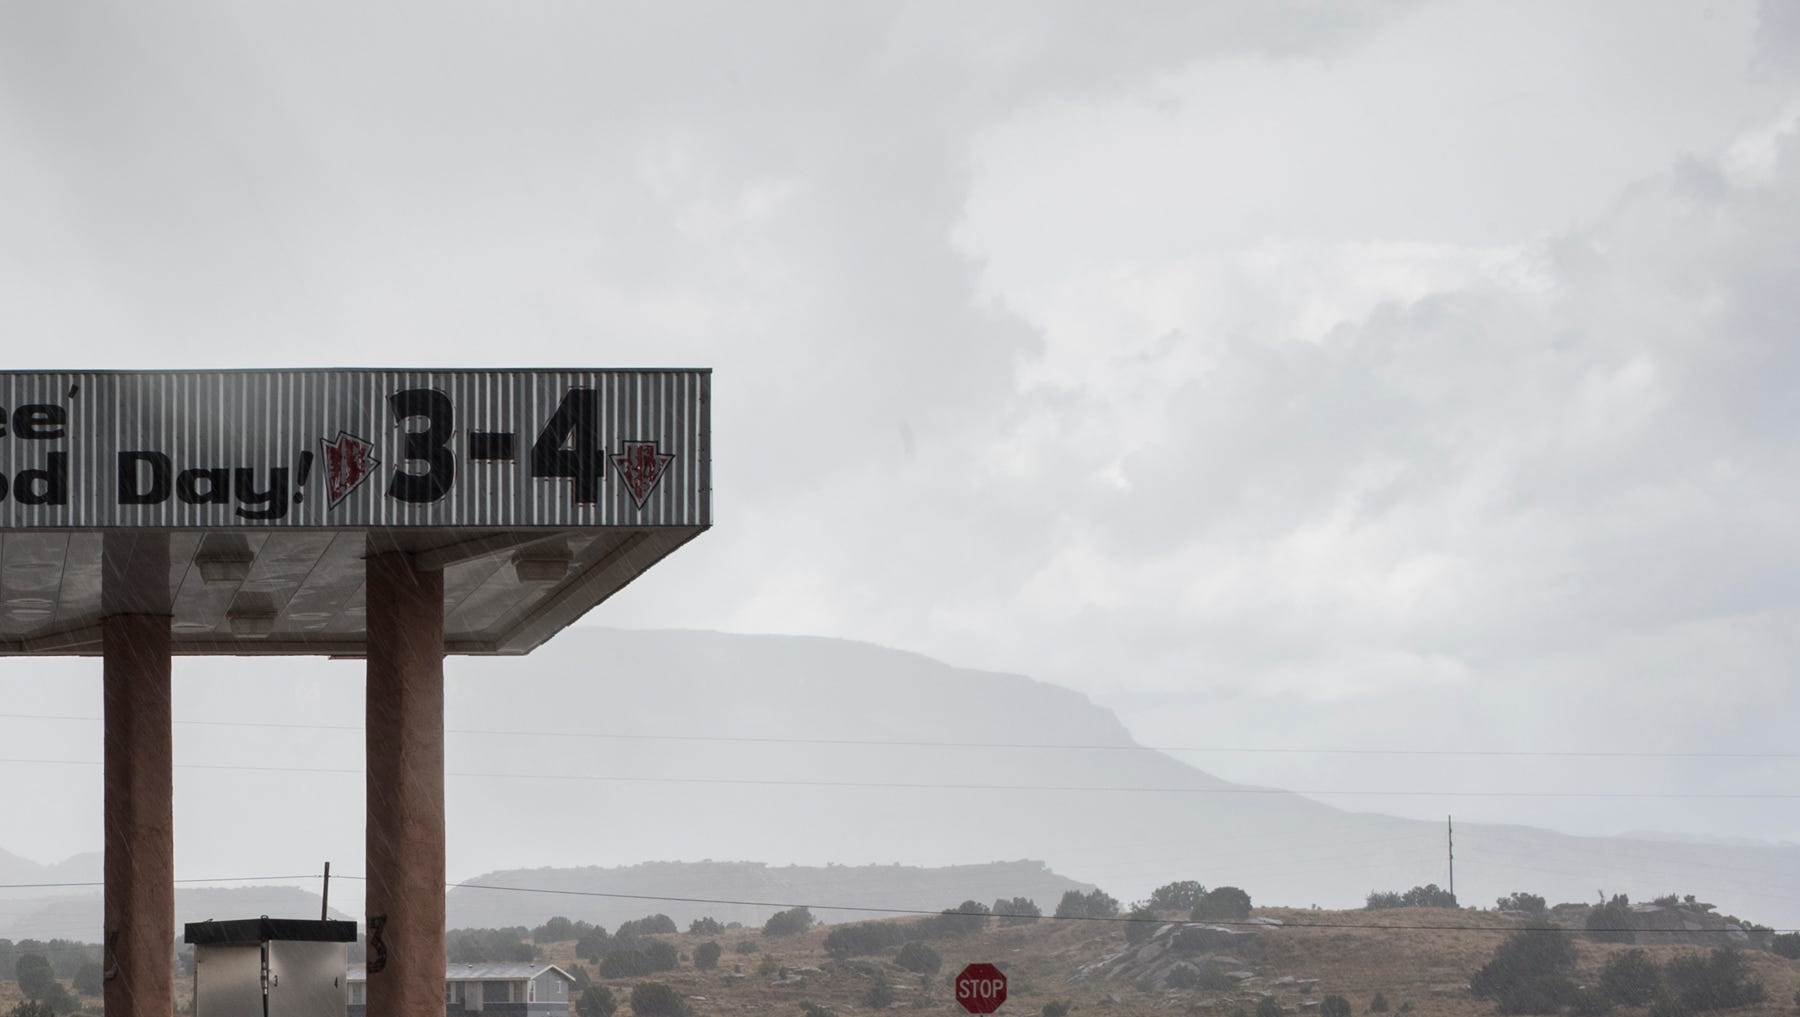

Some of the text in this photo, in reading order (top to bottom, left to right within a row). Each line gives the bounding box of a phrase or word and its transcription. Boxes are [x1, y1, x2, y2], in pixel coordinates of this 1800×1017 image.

[386, 387, 605, 508] 3-4
[117, 449, 314, 520] Day!
[959, 979, 1004, 998] STOP
